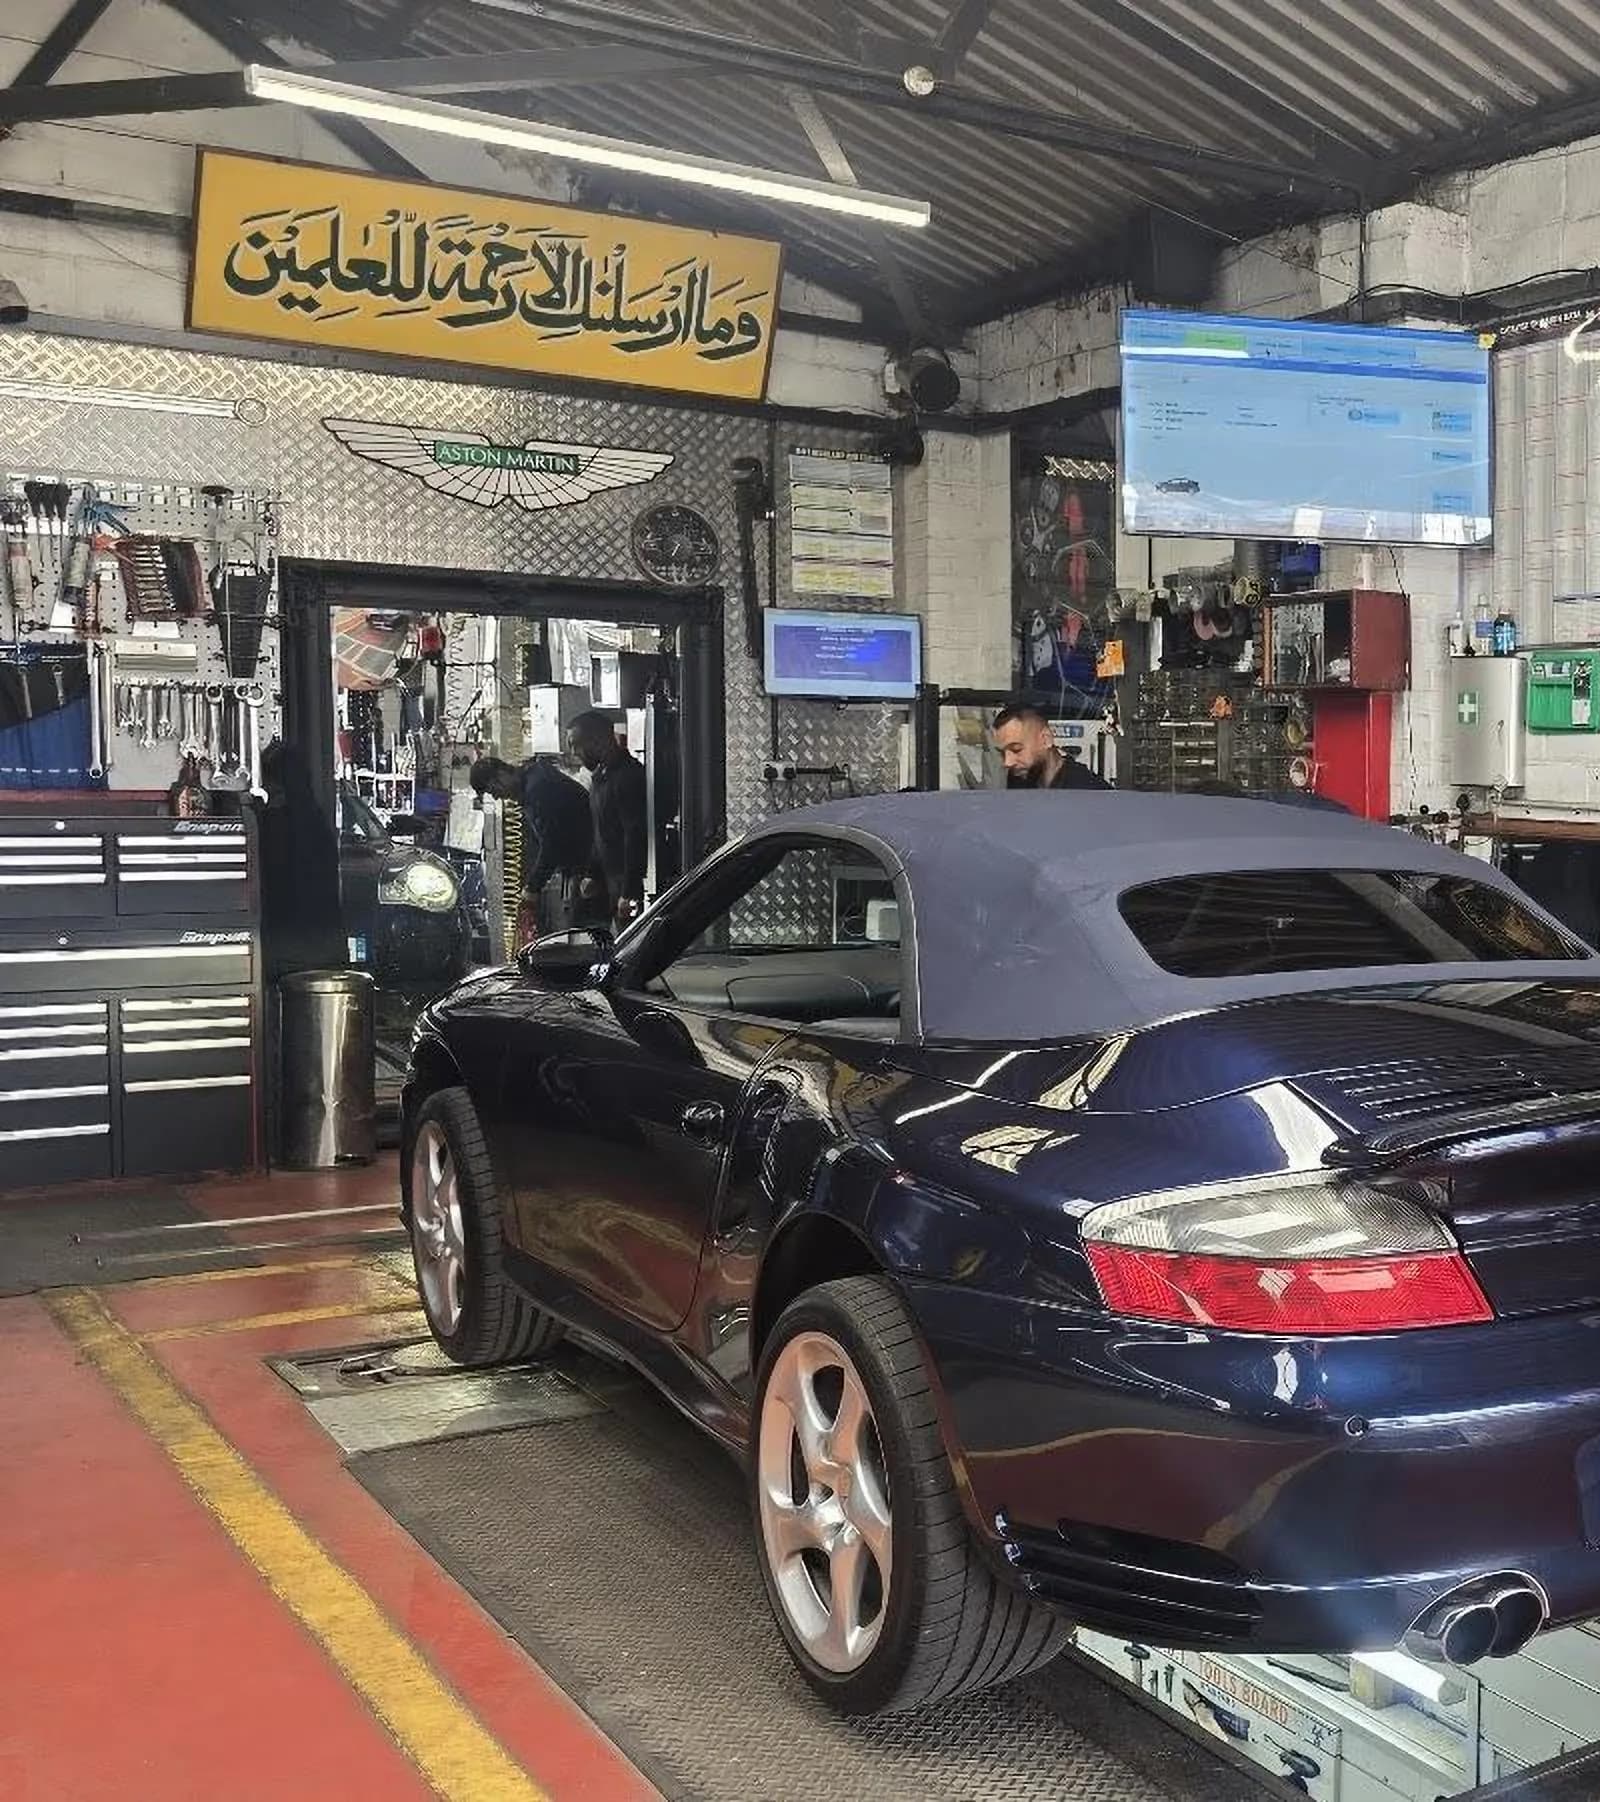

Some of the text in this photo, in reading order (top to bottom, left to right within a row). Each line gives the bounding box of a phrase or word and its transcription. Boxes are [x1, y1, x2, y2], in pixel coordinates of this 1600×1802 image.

[439, 445, 575, 472] ASTON MARTIN
[1242, 1684, 1289, 1727] BOARD
